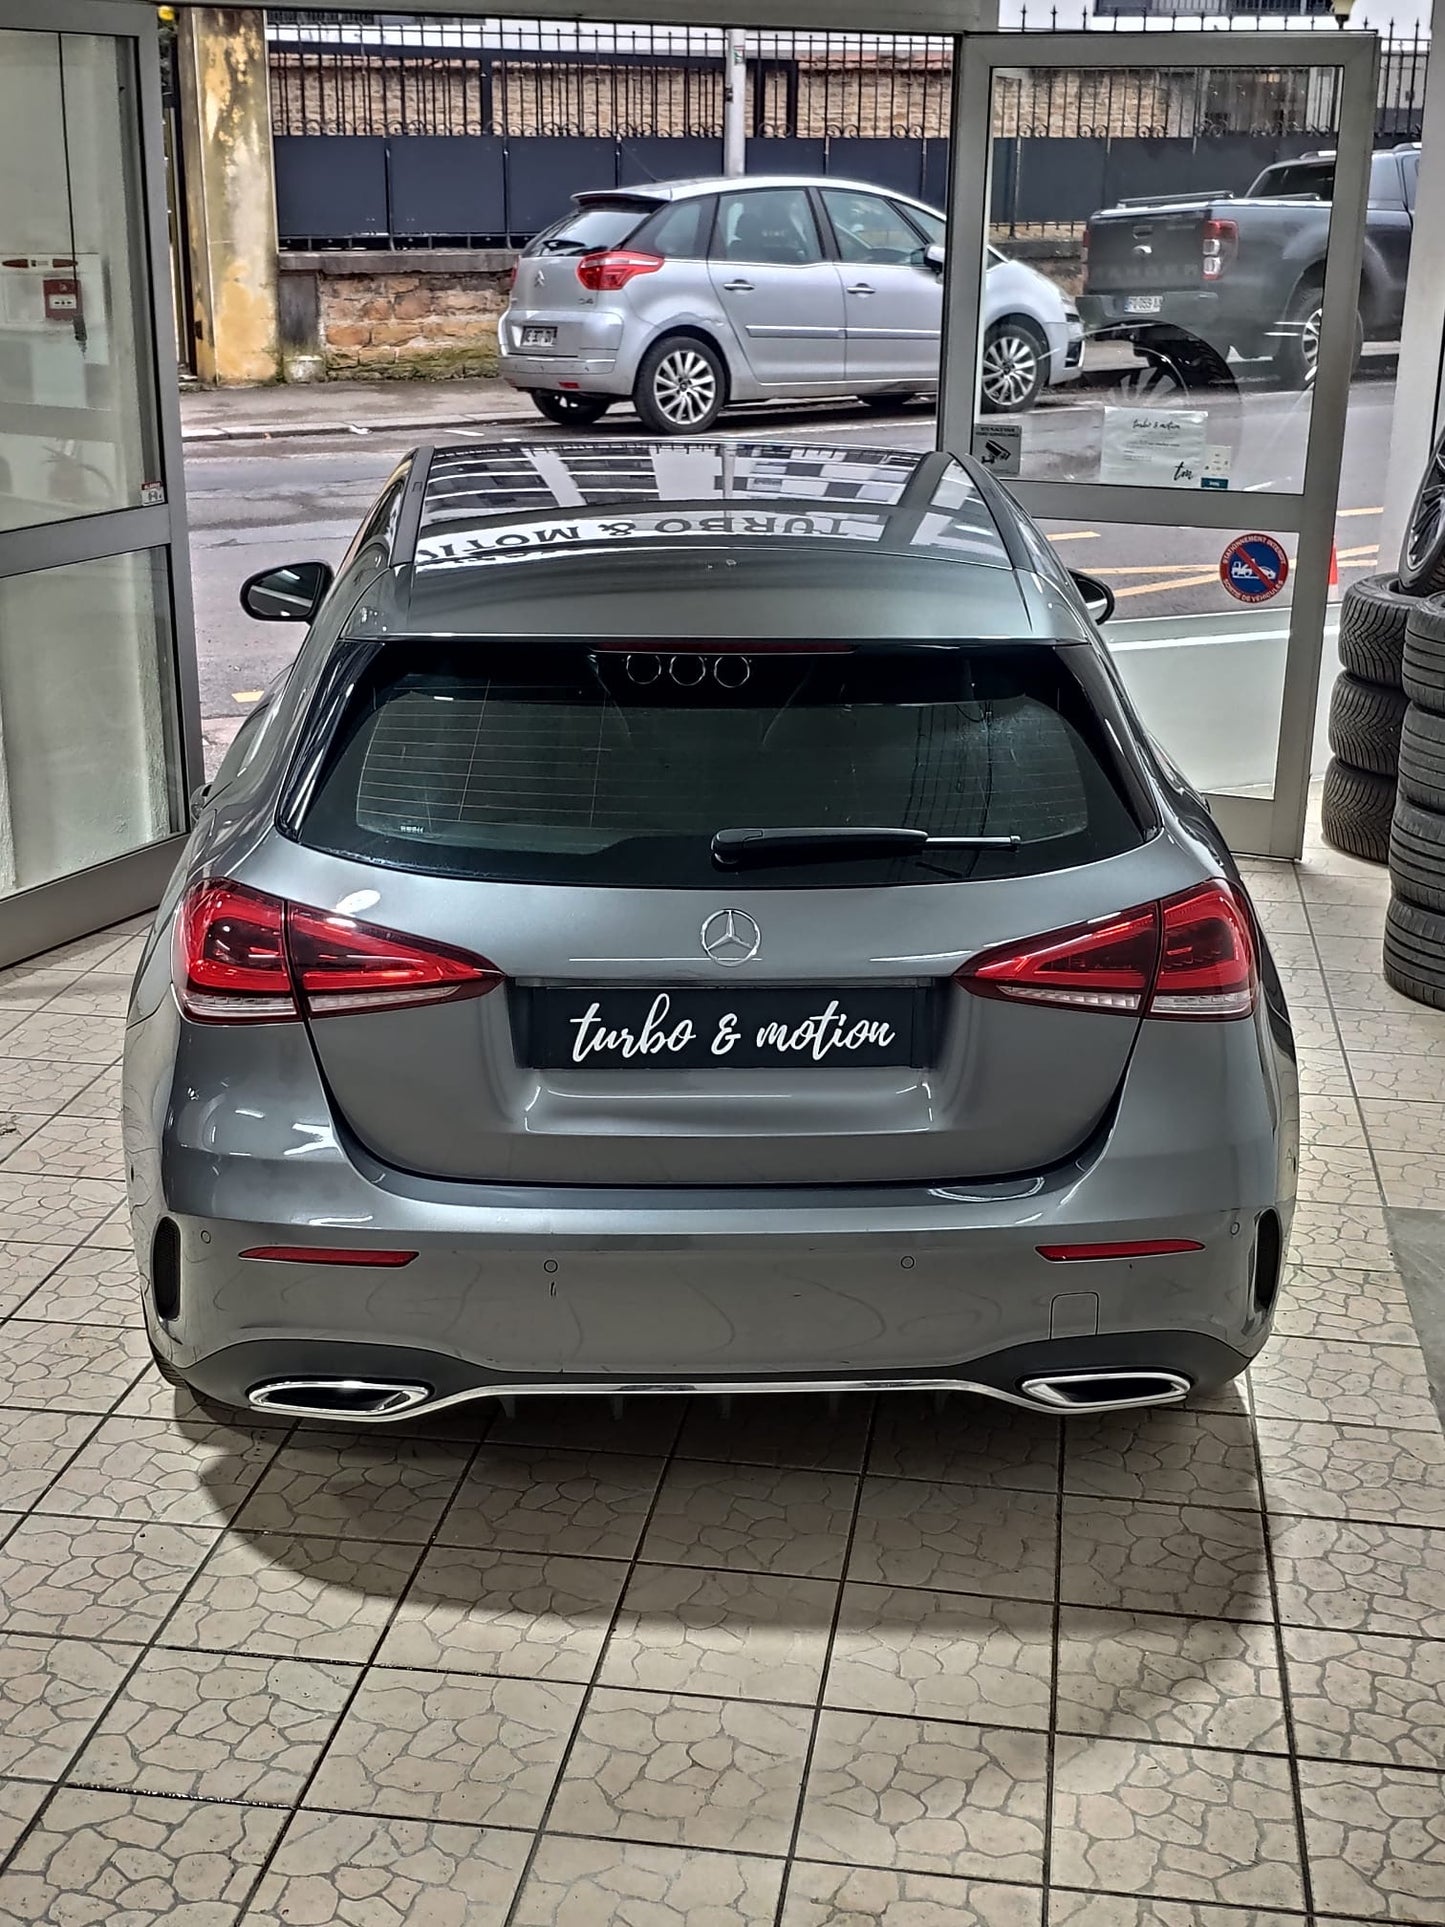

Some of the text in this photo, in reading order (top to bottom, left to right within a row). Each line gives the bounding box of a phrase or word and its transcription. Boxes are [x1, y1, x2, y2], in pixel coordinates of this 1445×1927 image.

[598, 522, 636, 536] &
[655, 517, 848, 535] TURBO
[570, 993, 896, 1062] turbo & motion
